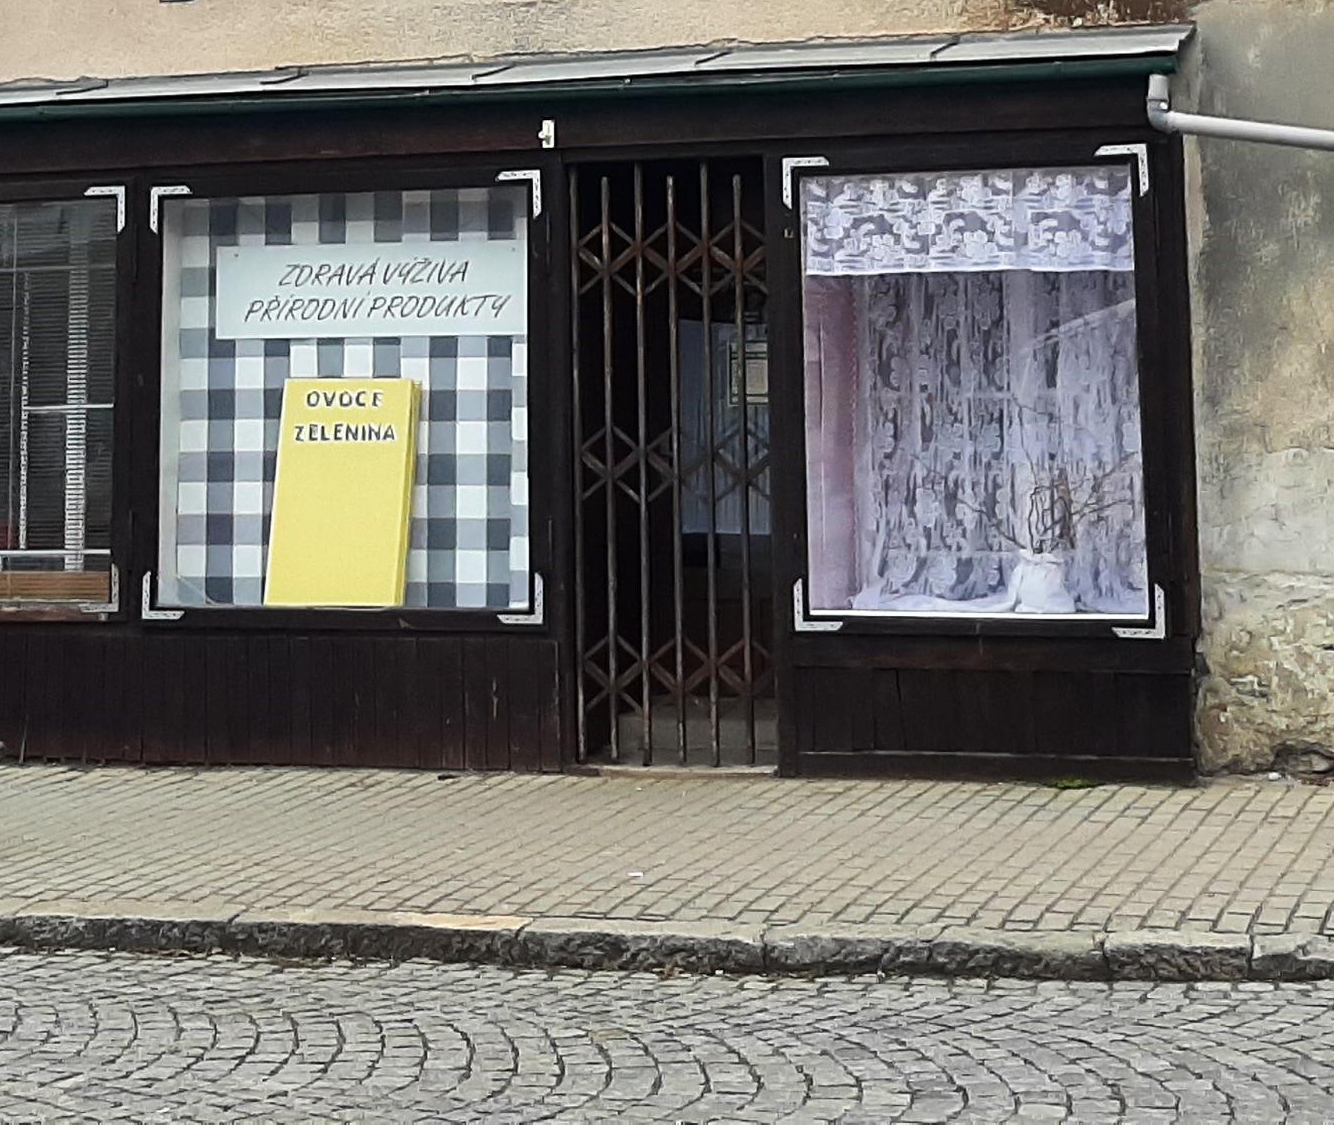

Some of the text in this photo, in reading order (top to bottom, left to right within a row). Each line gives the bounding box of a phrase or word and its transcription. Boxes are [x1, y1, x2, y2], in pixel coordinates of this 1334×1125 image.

[278, 257, 470, 287] ZDRAVÁ VÝŽIVA
[243, 290, 513, 323] PŘÍRODNÍ PRODUKTY
[306, 389, 385, 408] OVOCE
[294, 422, 396, 442] ZELENINA
